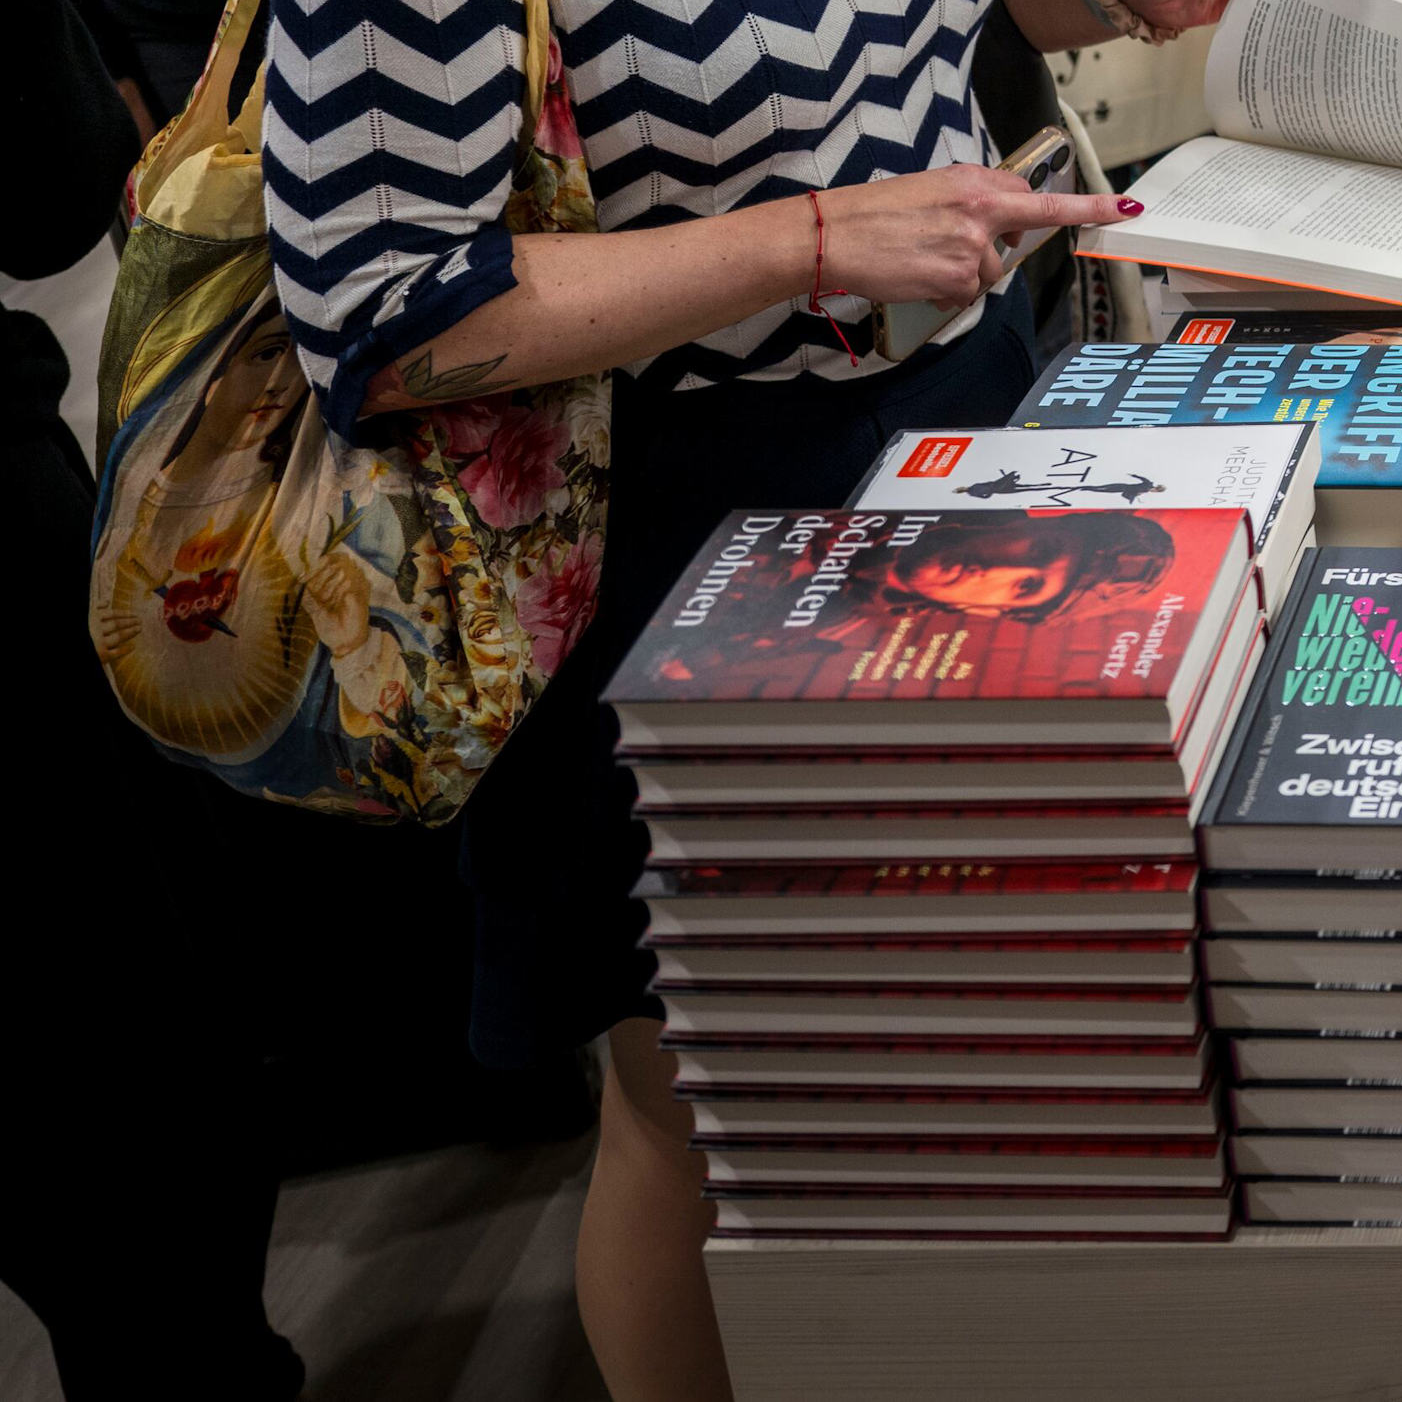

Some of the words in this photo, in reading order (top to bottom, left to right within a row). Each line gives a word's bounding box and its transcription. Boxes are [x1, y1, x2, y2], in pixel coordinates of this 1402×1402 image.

[1037, 343, 1143, 408] DÄRE
[1200, 344, 1296, 420] TECH-
[1290, 344, 1371, 390] DER
[887, 514, 943, 547] Im
[672, 515, 784, 628] Drohnen
[782, 513, 887, 629] Schatten
[1134, 591, 1185, 680] Alexander
